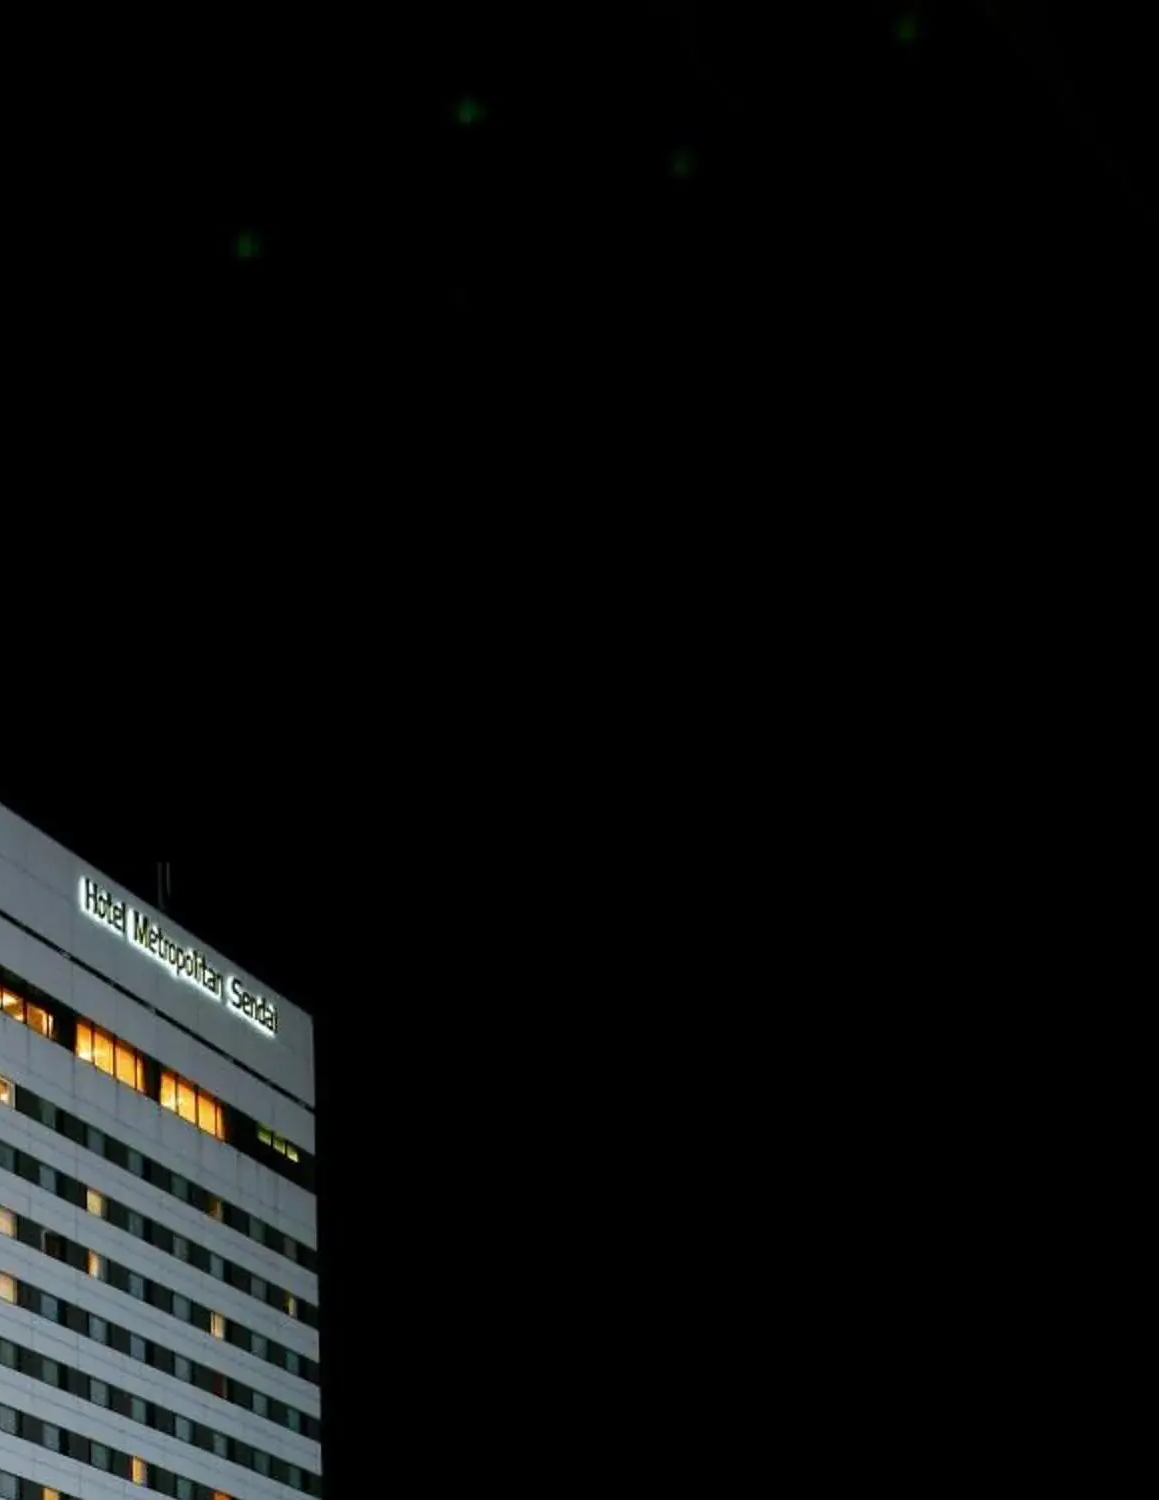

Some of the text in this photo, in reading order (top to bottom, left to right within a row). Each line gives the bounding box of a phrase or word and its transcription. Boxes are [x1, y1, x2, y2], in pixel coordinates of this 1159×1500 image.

[83, 877, 279, 1035] Hotel Metropolitan Sendai
